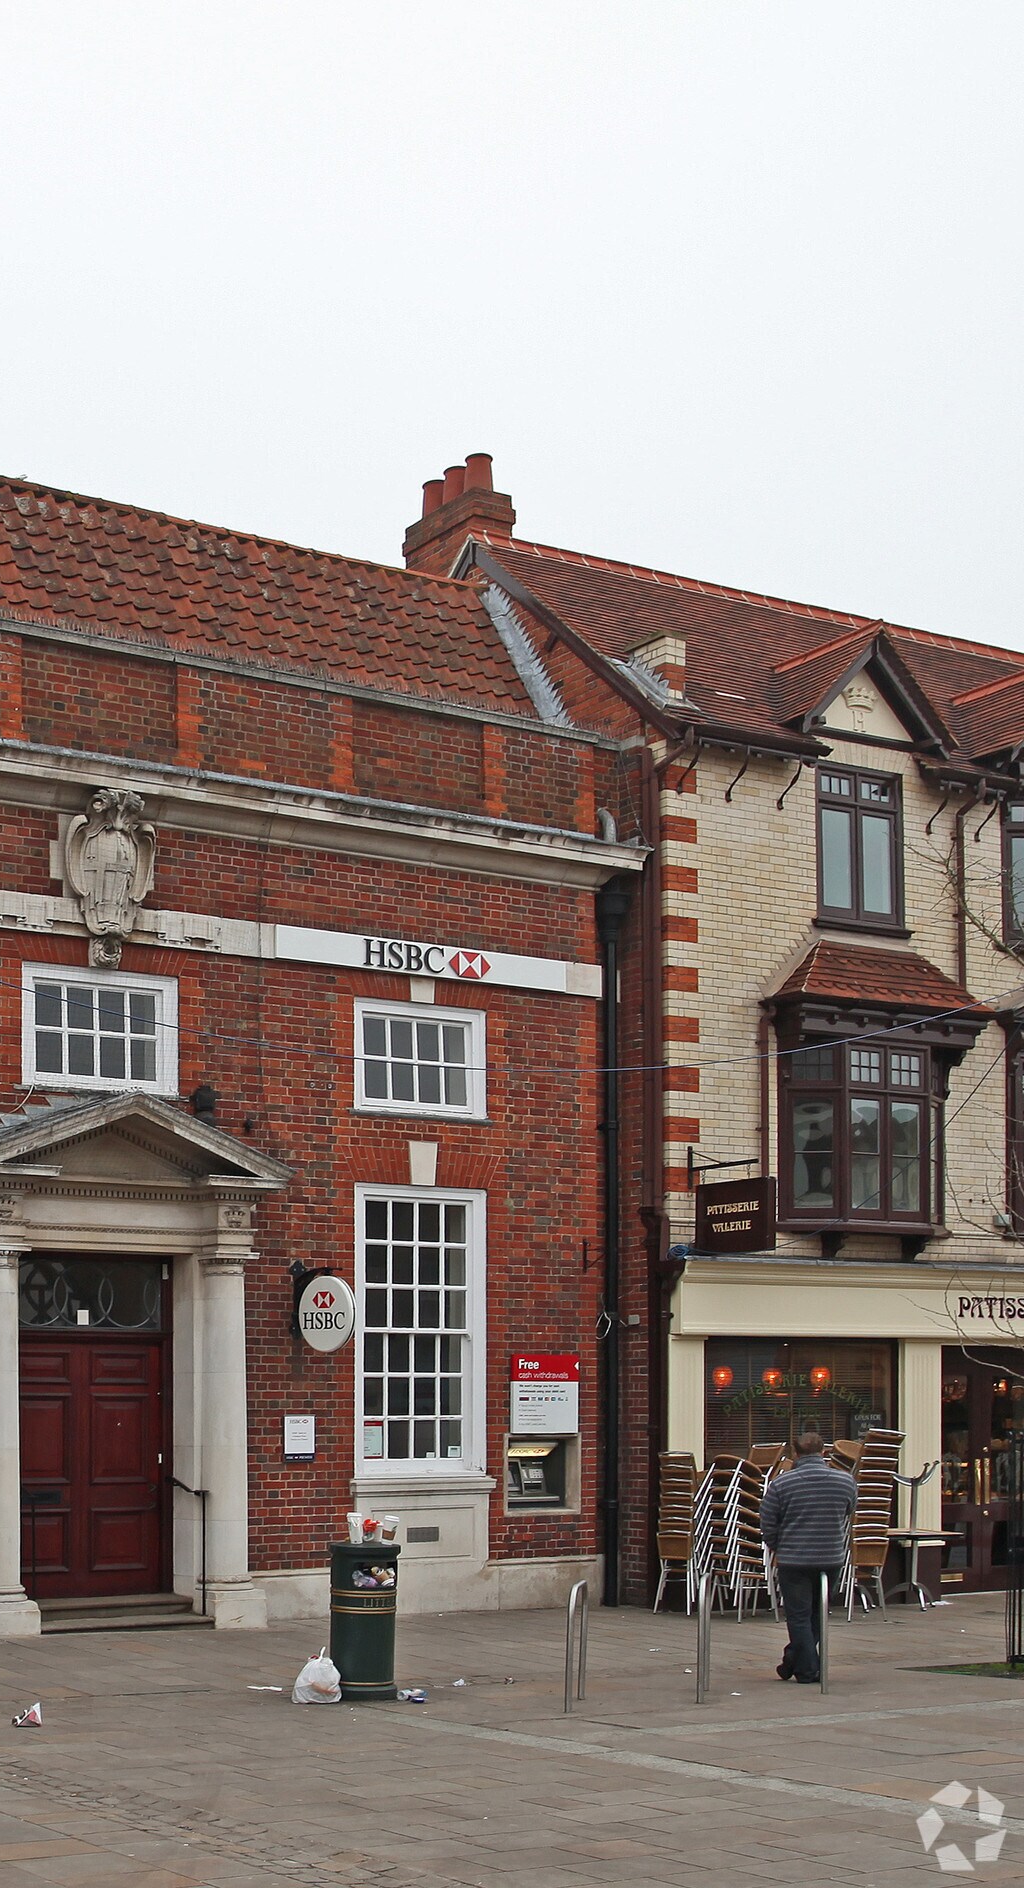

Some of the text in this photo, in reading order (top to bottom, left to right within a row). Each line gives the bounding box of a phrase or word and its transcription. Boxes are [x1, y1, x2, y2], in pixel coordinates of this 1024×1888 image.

[363, 938, 446, 974] HSBC
[707, 1200, 760, 1215] PATISSERIE
[712, 1219, 752, 1232] VALERIE
[302, 1311, 346, 1330] HSBC
[518, 1358, 540, 1370] Free
[817, 1377, 871, 1414] ALERIE
